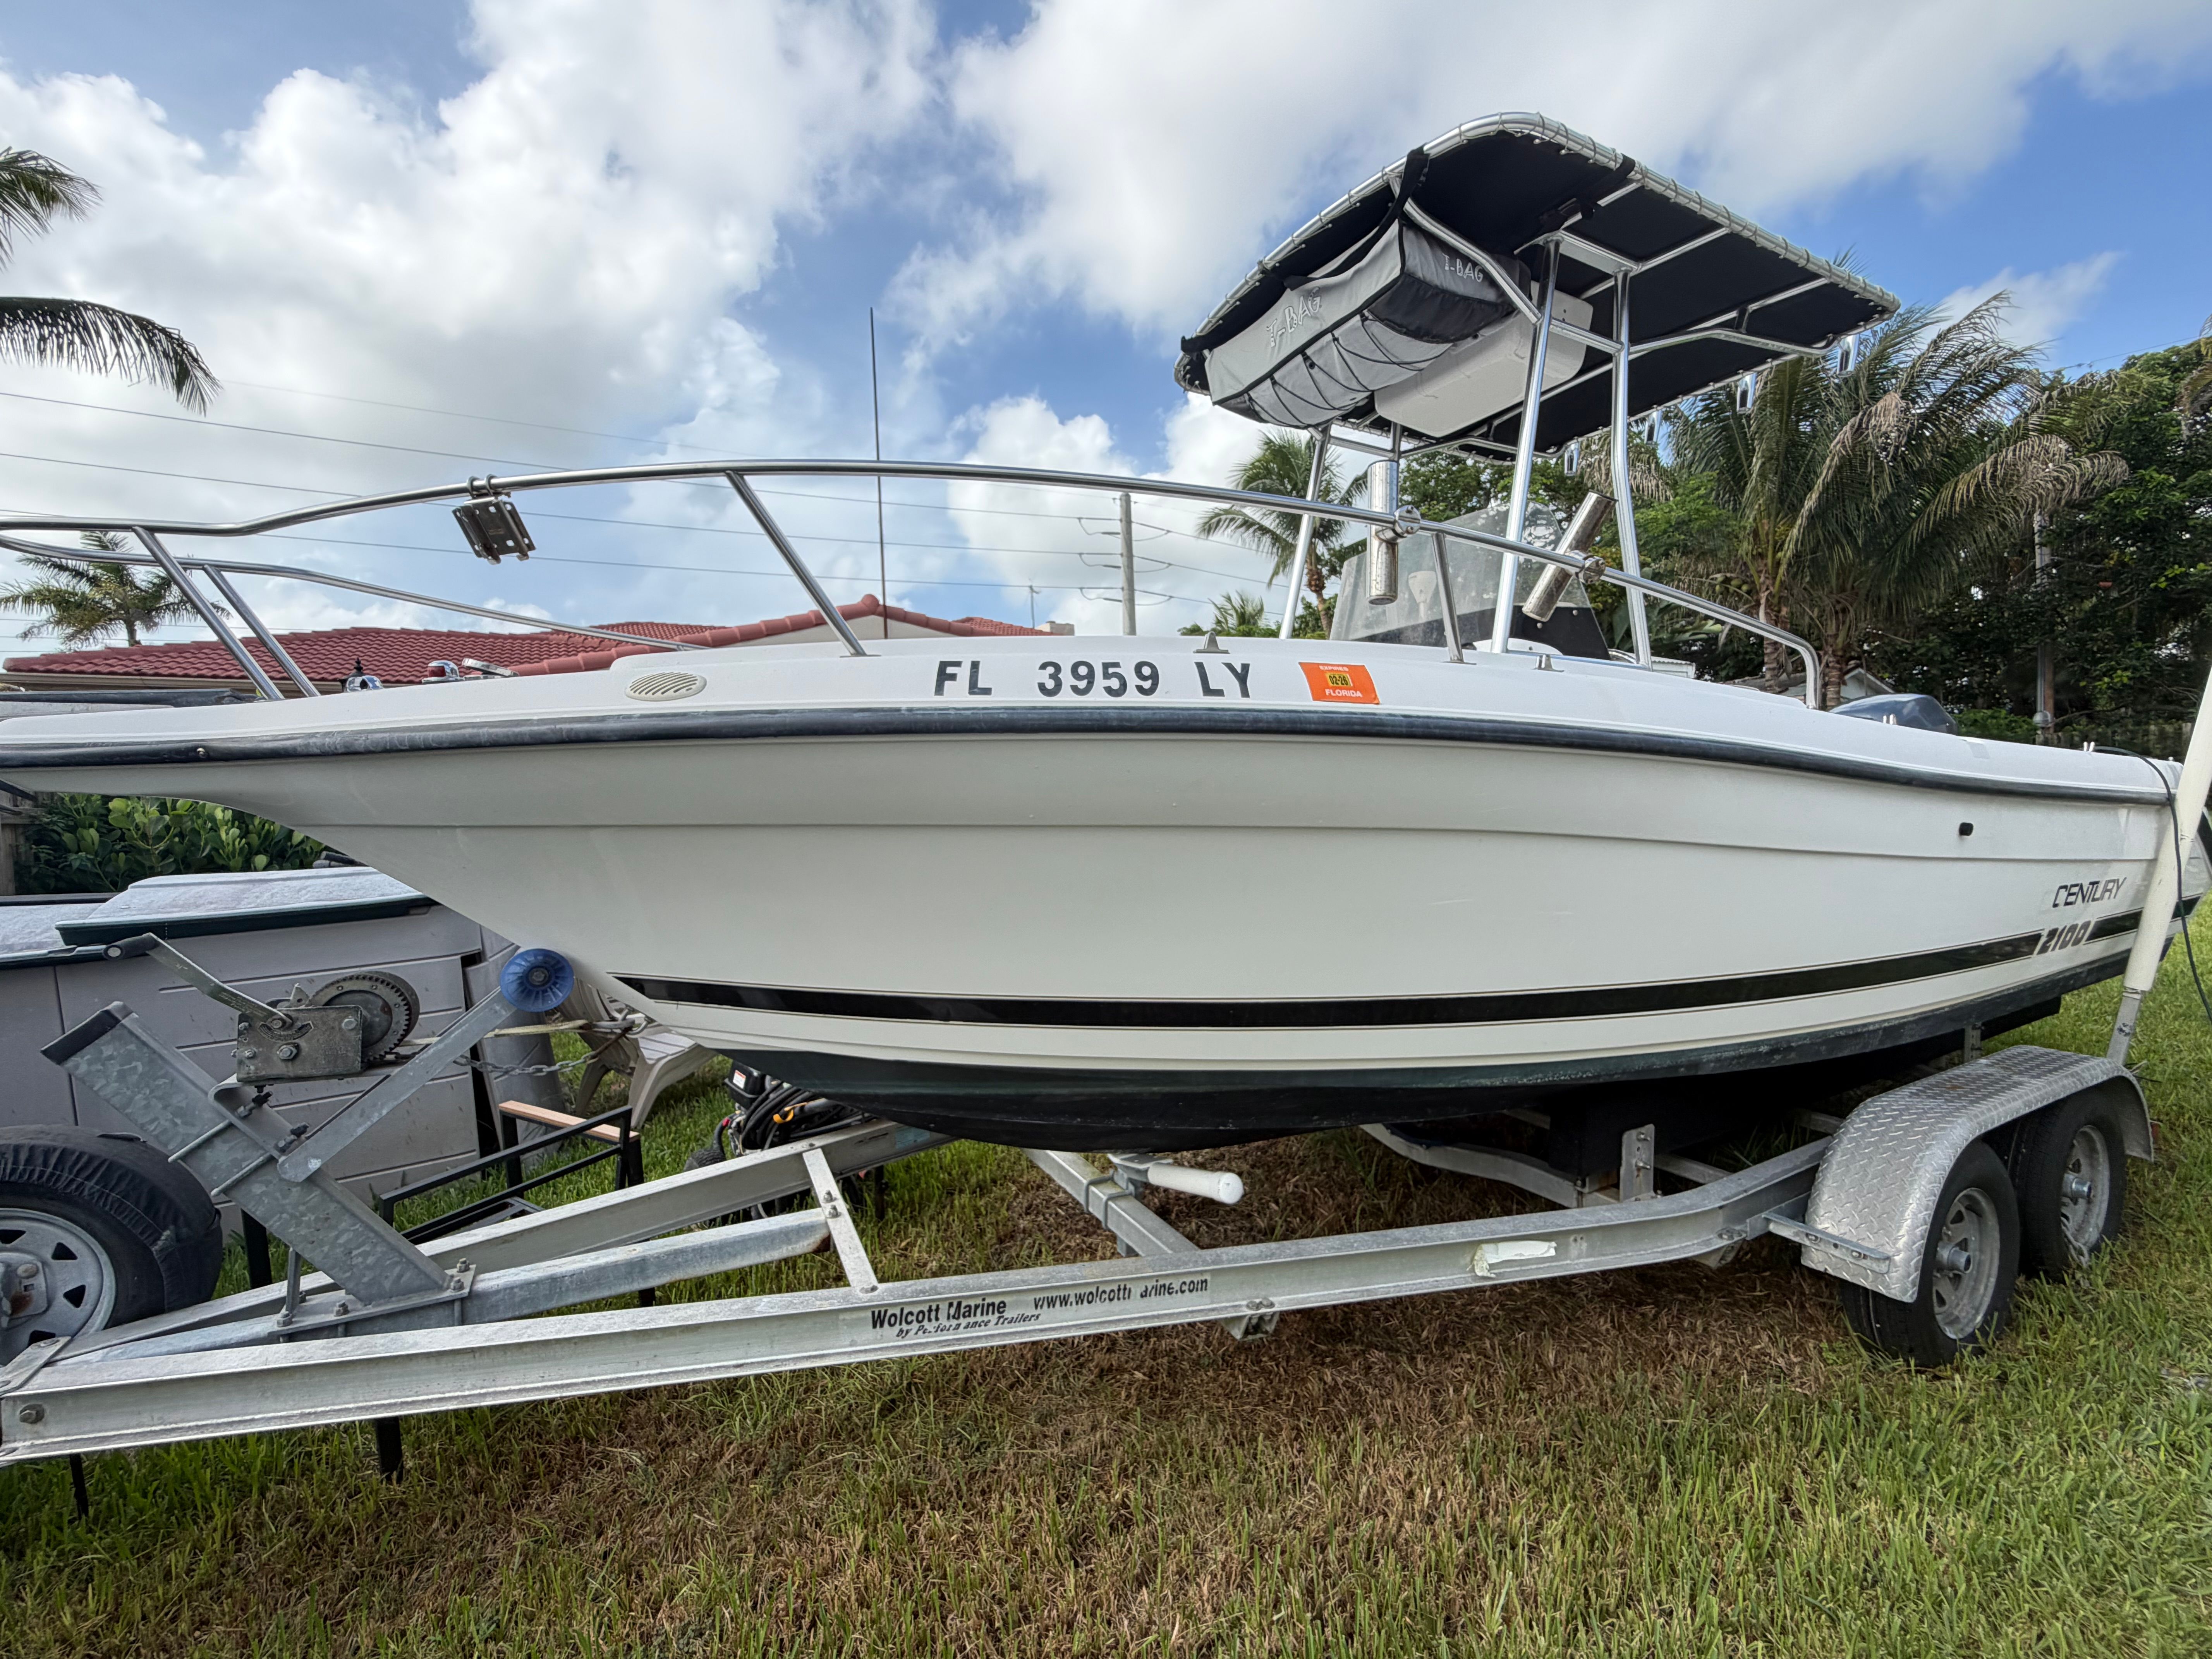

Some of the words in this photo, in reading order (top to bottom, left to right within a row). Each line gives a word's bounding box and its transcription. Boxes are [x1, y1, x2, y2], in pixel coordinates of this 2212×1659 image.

[1442, 252, 1483, 282] T-BAG
[1266, 286, 1321, 347] T-BAG
[934, 660, 992, 696] FL
[1037, 660, 1159, 697] 3959
[1194, 661, 1250, 699] LY
[1325, 689, 1363, 697] FLORIDA
[1329, 675, 1348, 685] 02-26
[2052, 877, 2127, 908] CENTURY
[2036, 920, 2092, 955] 2100
[871, 1304, 940, 1329] Wolcott
[896, 1327, 912, 1339] by
[994, 1312, 1041, 1326] Trailers
